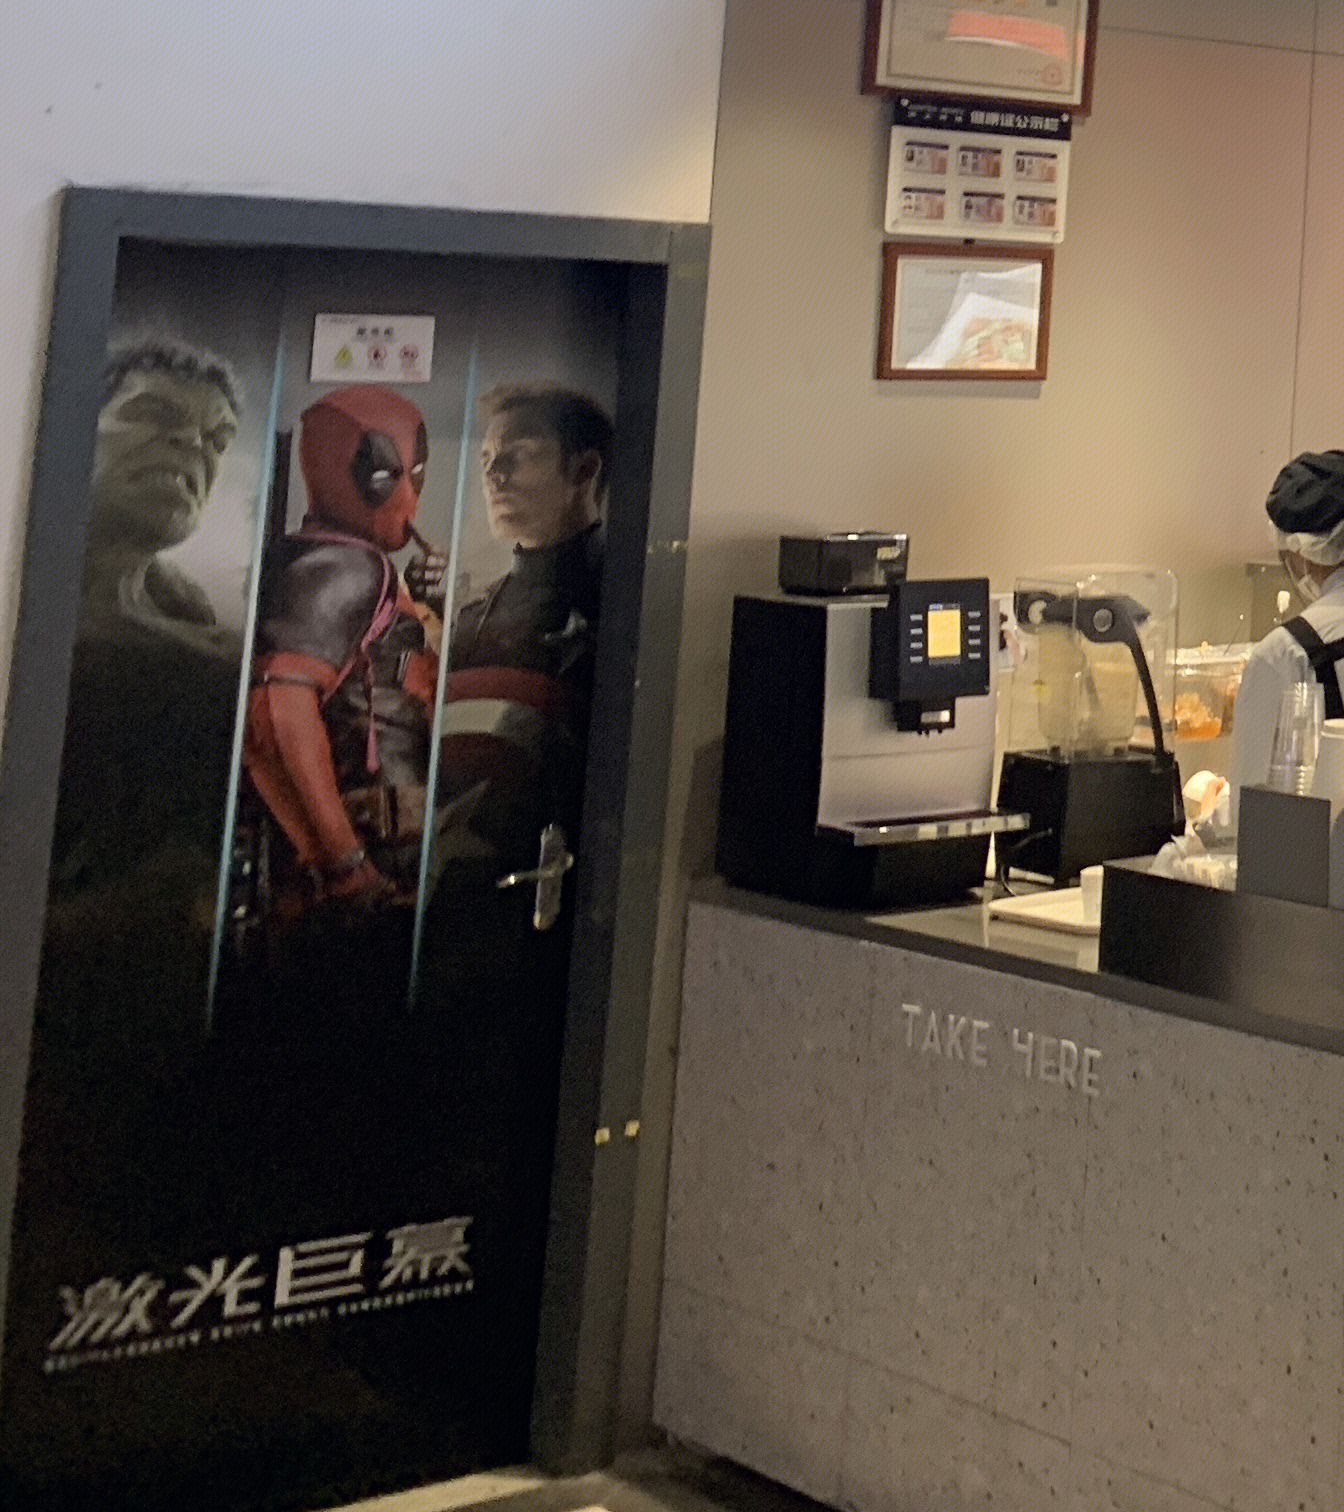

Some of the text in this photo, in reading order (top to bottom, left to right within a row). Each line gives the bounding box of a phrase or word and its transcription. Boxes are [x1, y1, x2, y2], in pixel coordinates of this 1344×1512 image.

[901, 1002, 1103, 1097] TAKE HERE
[49, 1215, 475, 1352] 激光巨幕
